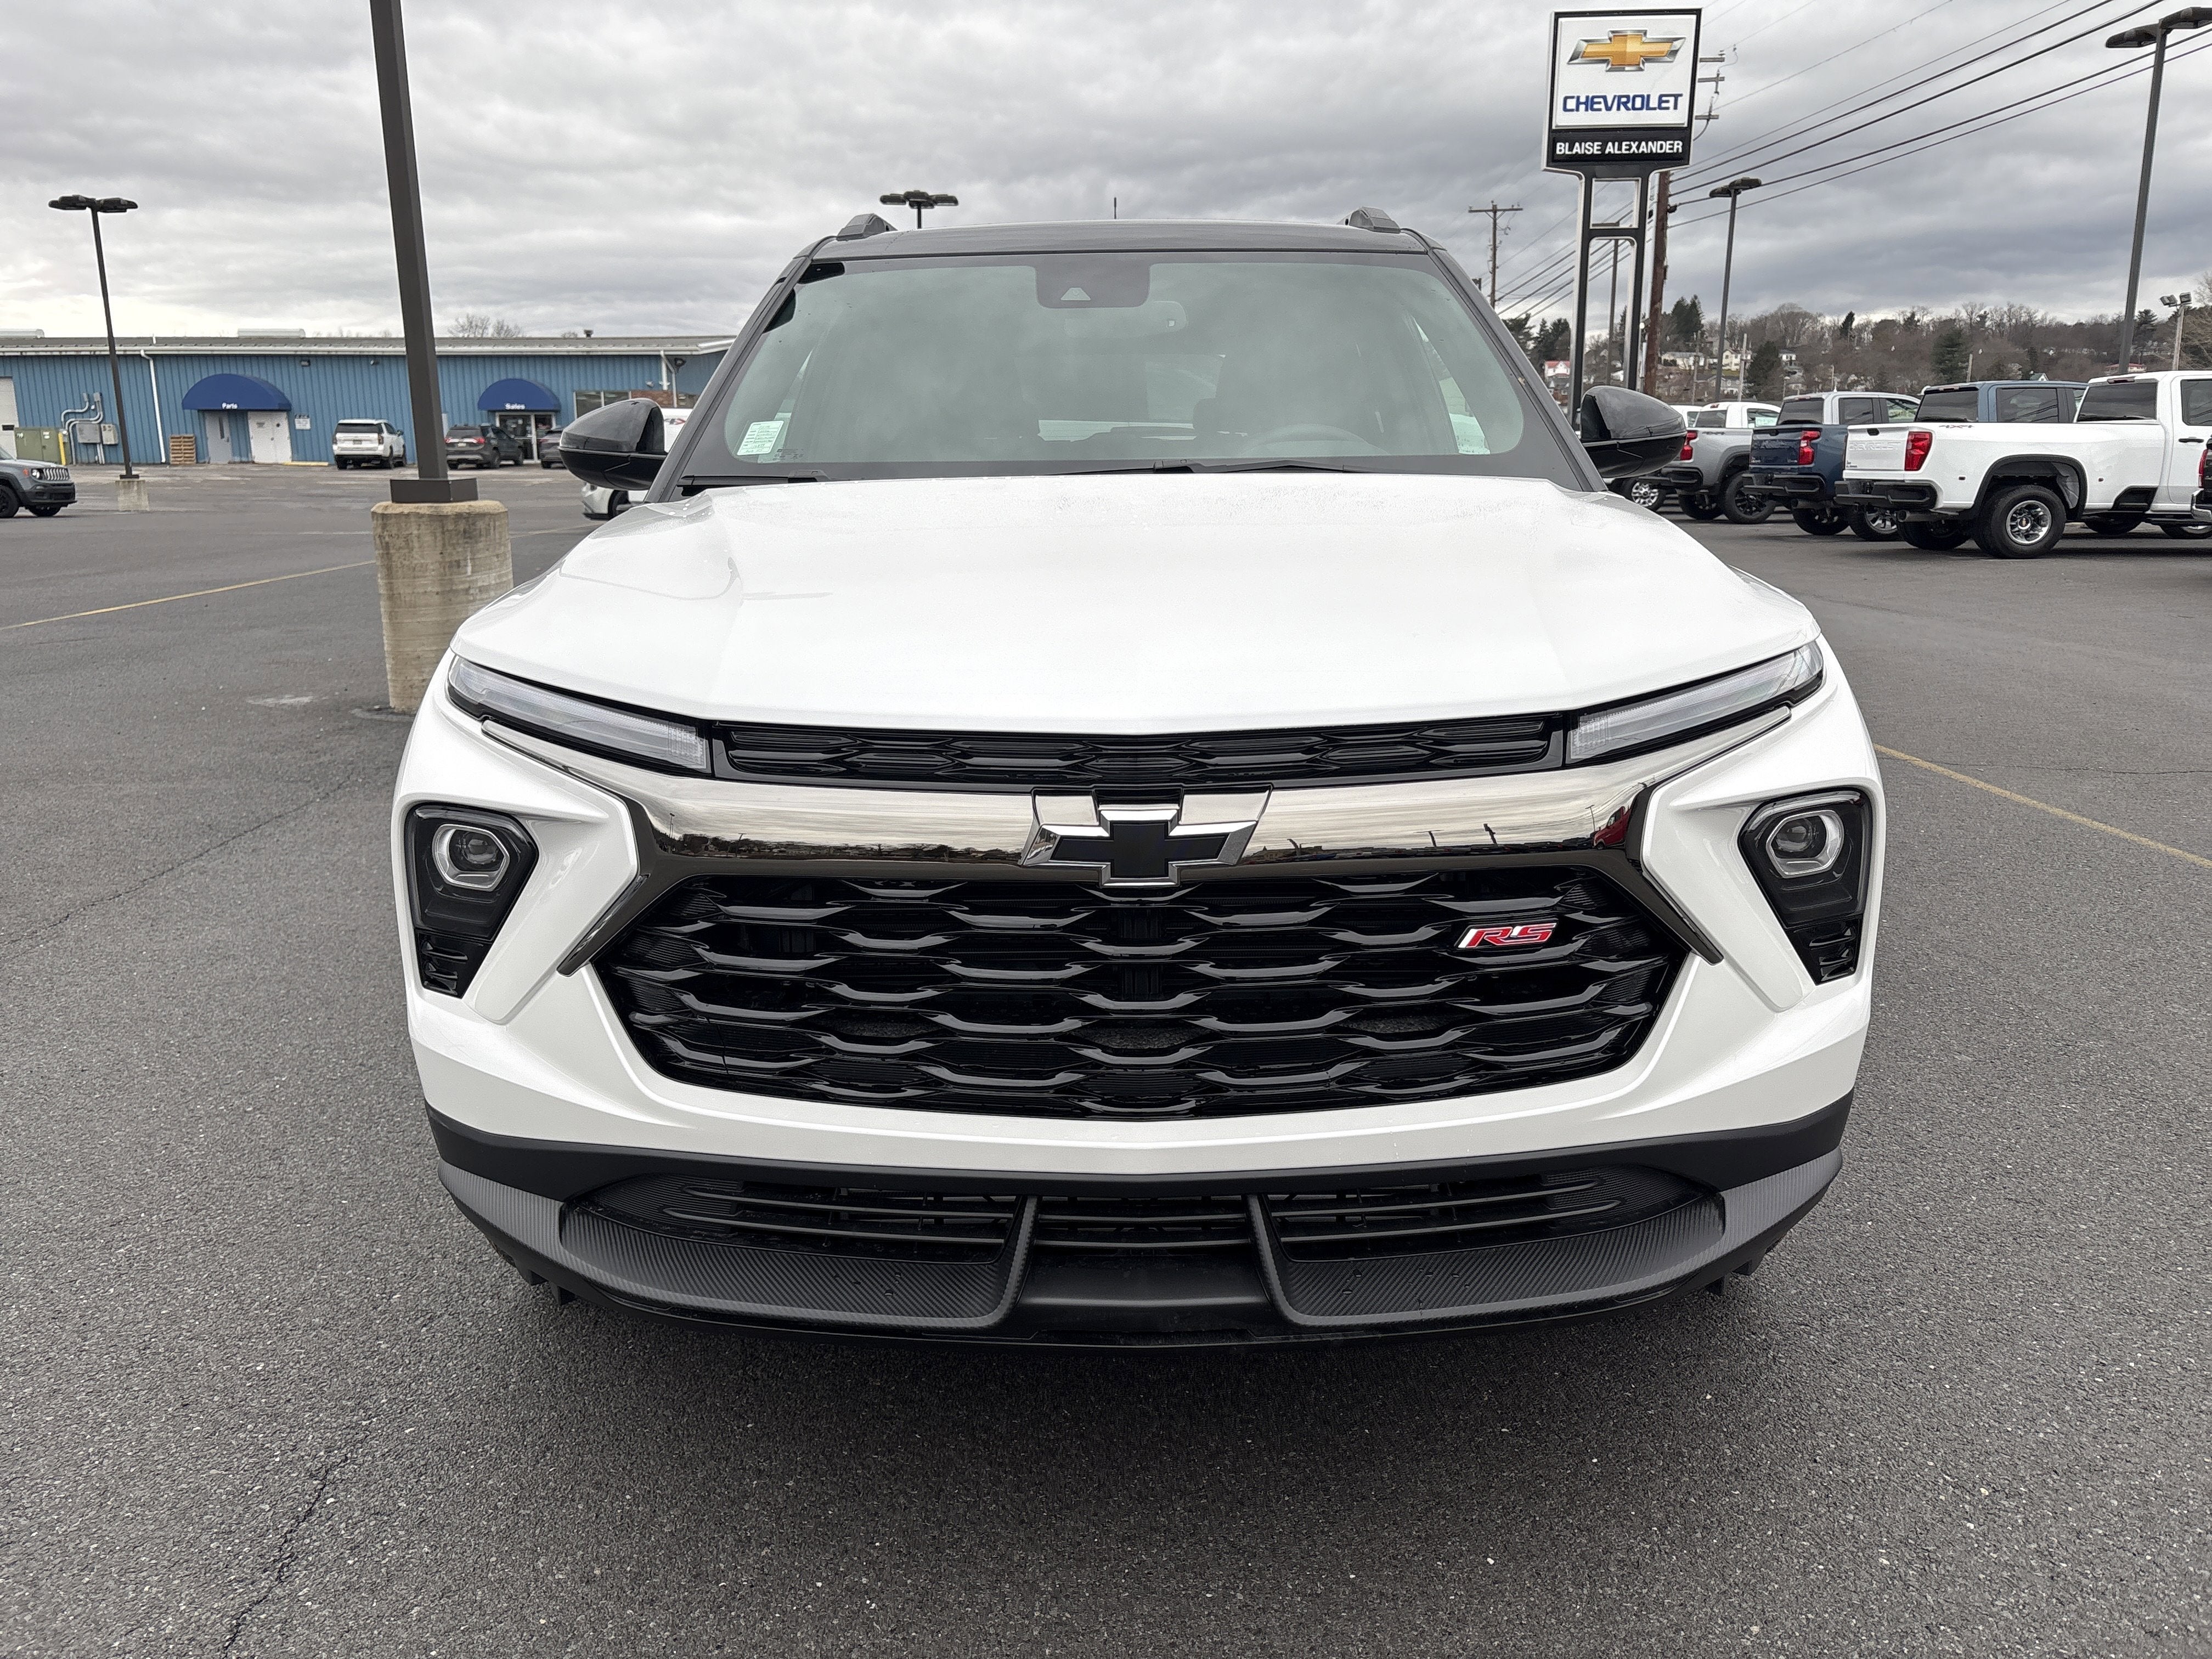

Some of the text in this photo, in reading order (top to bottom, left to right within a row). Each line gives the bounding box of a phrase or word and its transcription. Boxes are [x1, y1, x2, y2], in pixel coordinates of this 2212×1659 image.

[1563, 93, 1683, 112] CHEVROLET
[1556, 140, 1683, 155] BLAISE ALEXANDER
[1458, 923, 1557, 949] RS
